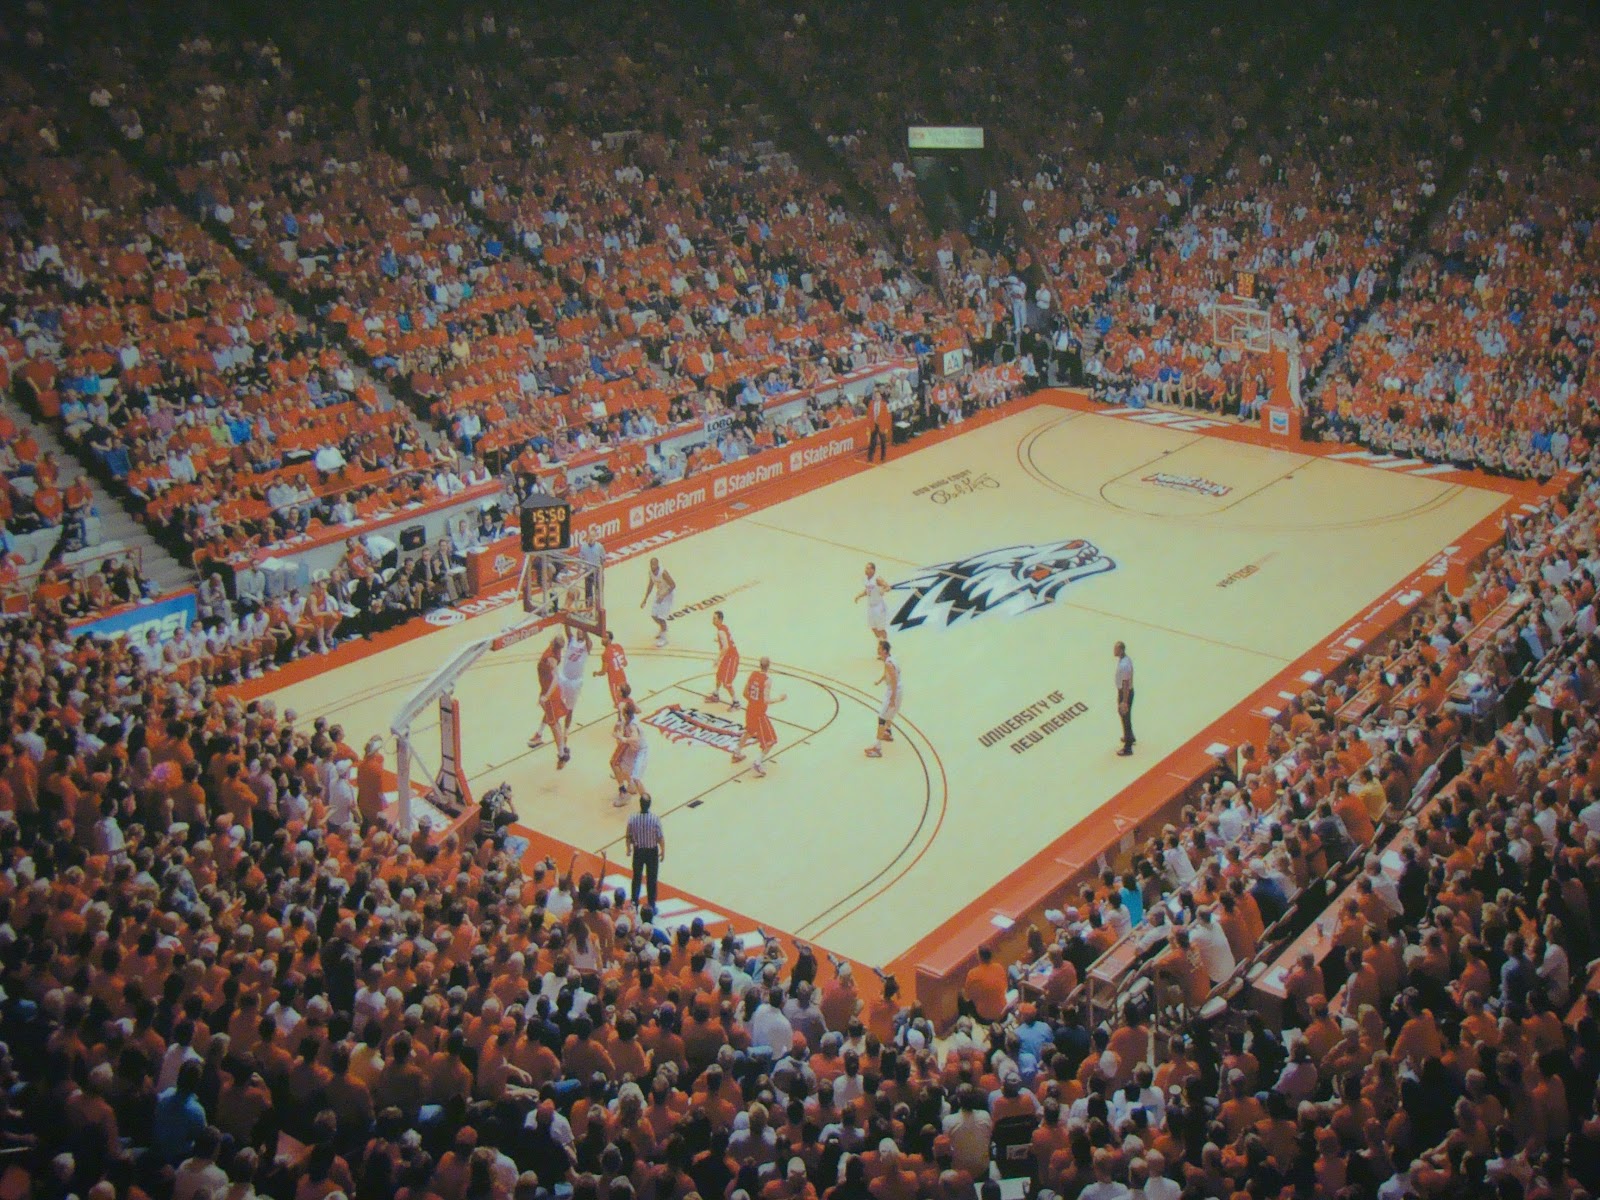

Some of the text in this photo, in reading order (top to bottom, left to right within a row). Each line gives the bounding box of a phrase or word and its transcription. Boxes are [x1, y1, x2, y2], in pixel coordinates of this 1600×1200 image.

[533, 523, 561, 550] 23
[667, 594, 727, 622] verizon
[978, 689, 1065, 748] UNIVERSITY OF
[1010, 701, 1089, 754] NEW MEXICO
